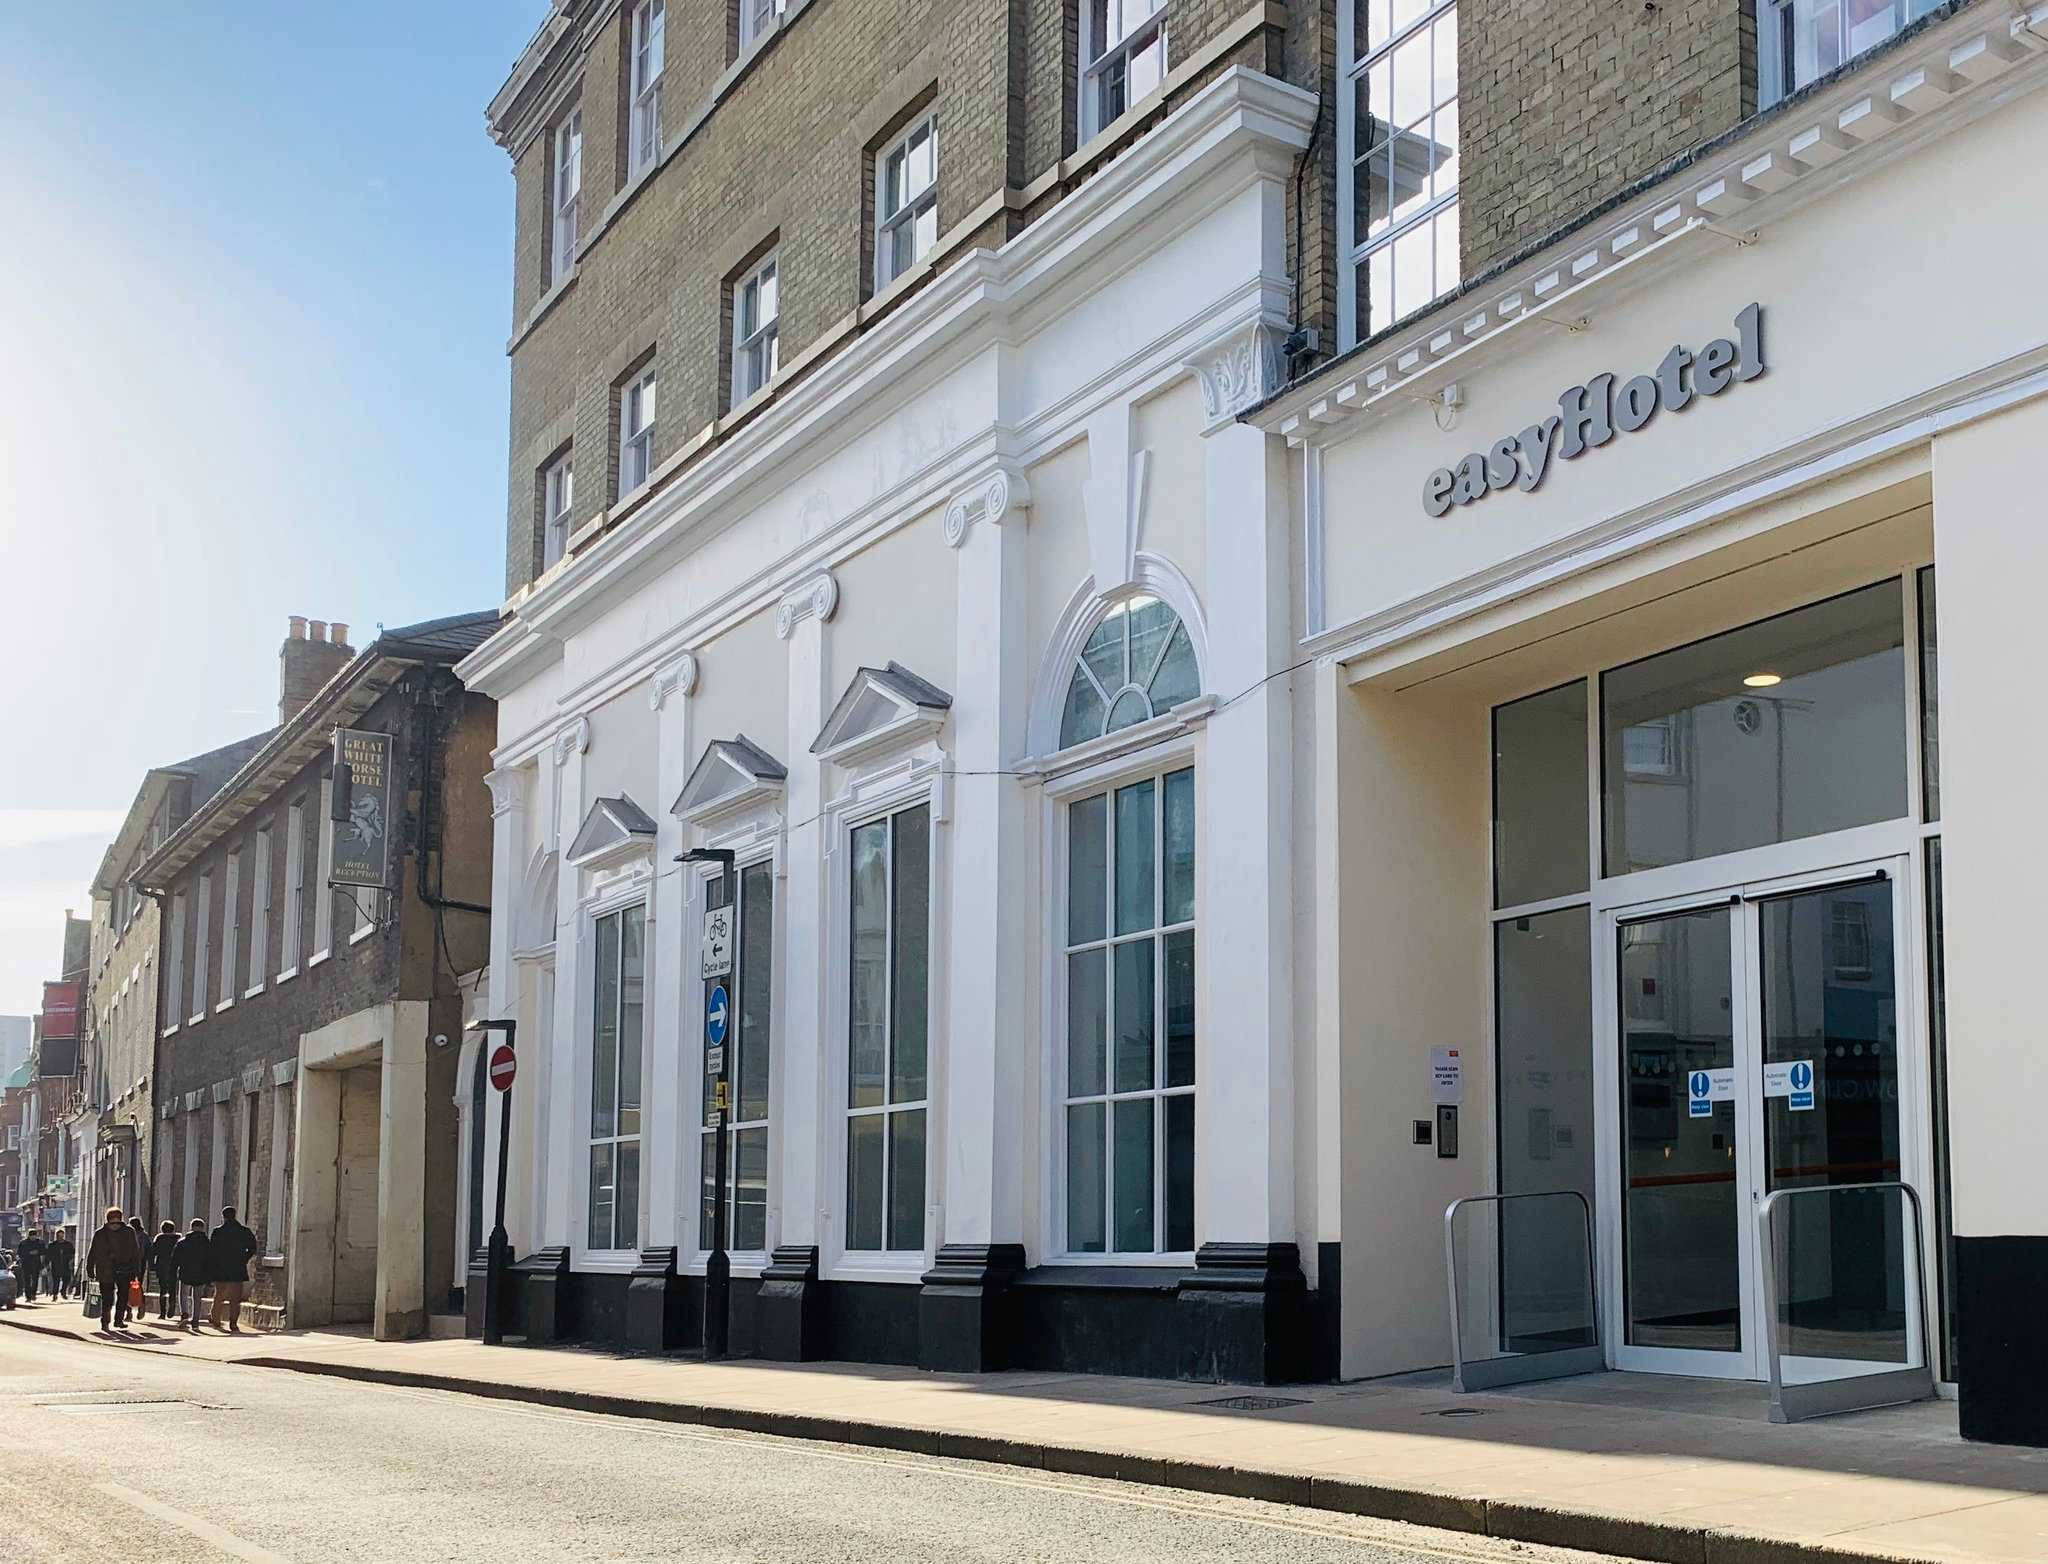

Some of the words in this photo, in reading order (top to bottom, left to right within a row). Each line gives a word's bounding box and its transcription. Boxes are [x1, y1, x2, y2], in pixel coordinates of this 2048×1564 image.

[1422, 302, 1765, 517] easyHotel
[344, 739, 384, 753] GREAT
[344, 750, 384, 764] WHITE
[345, 761, 384, 776] ORSE
[351, 774, 383, 788] OTEL
[704, 961, 718, 975] Cycle
